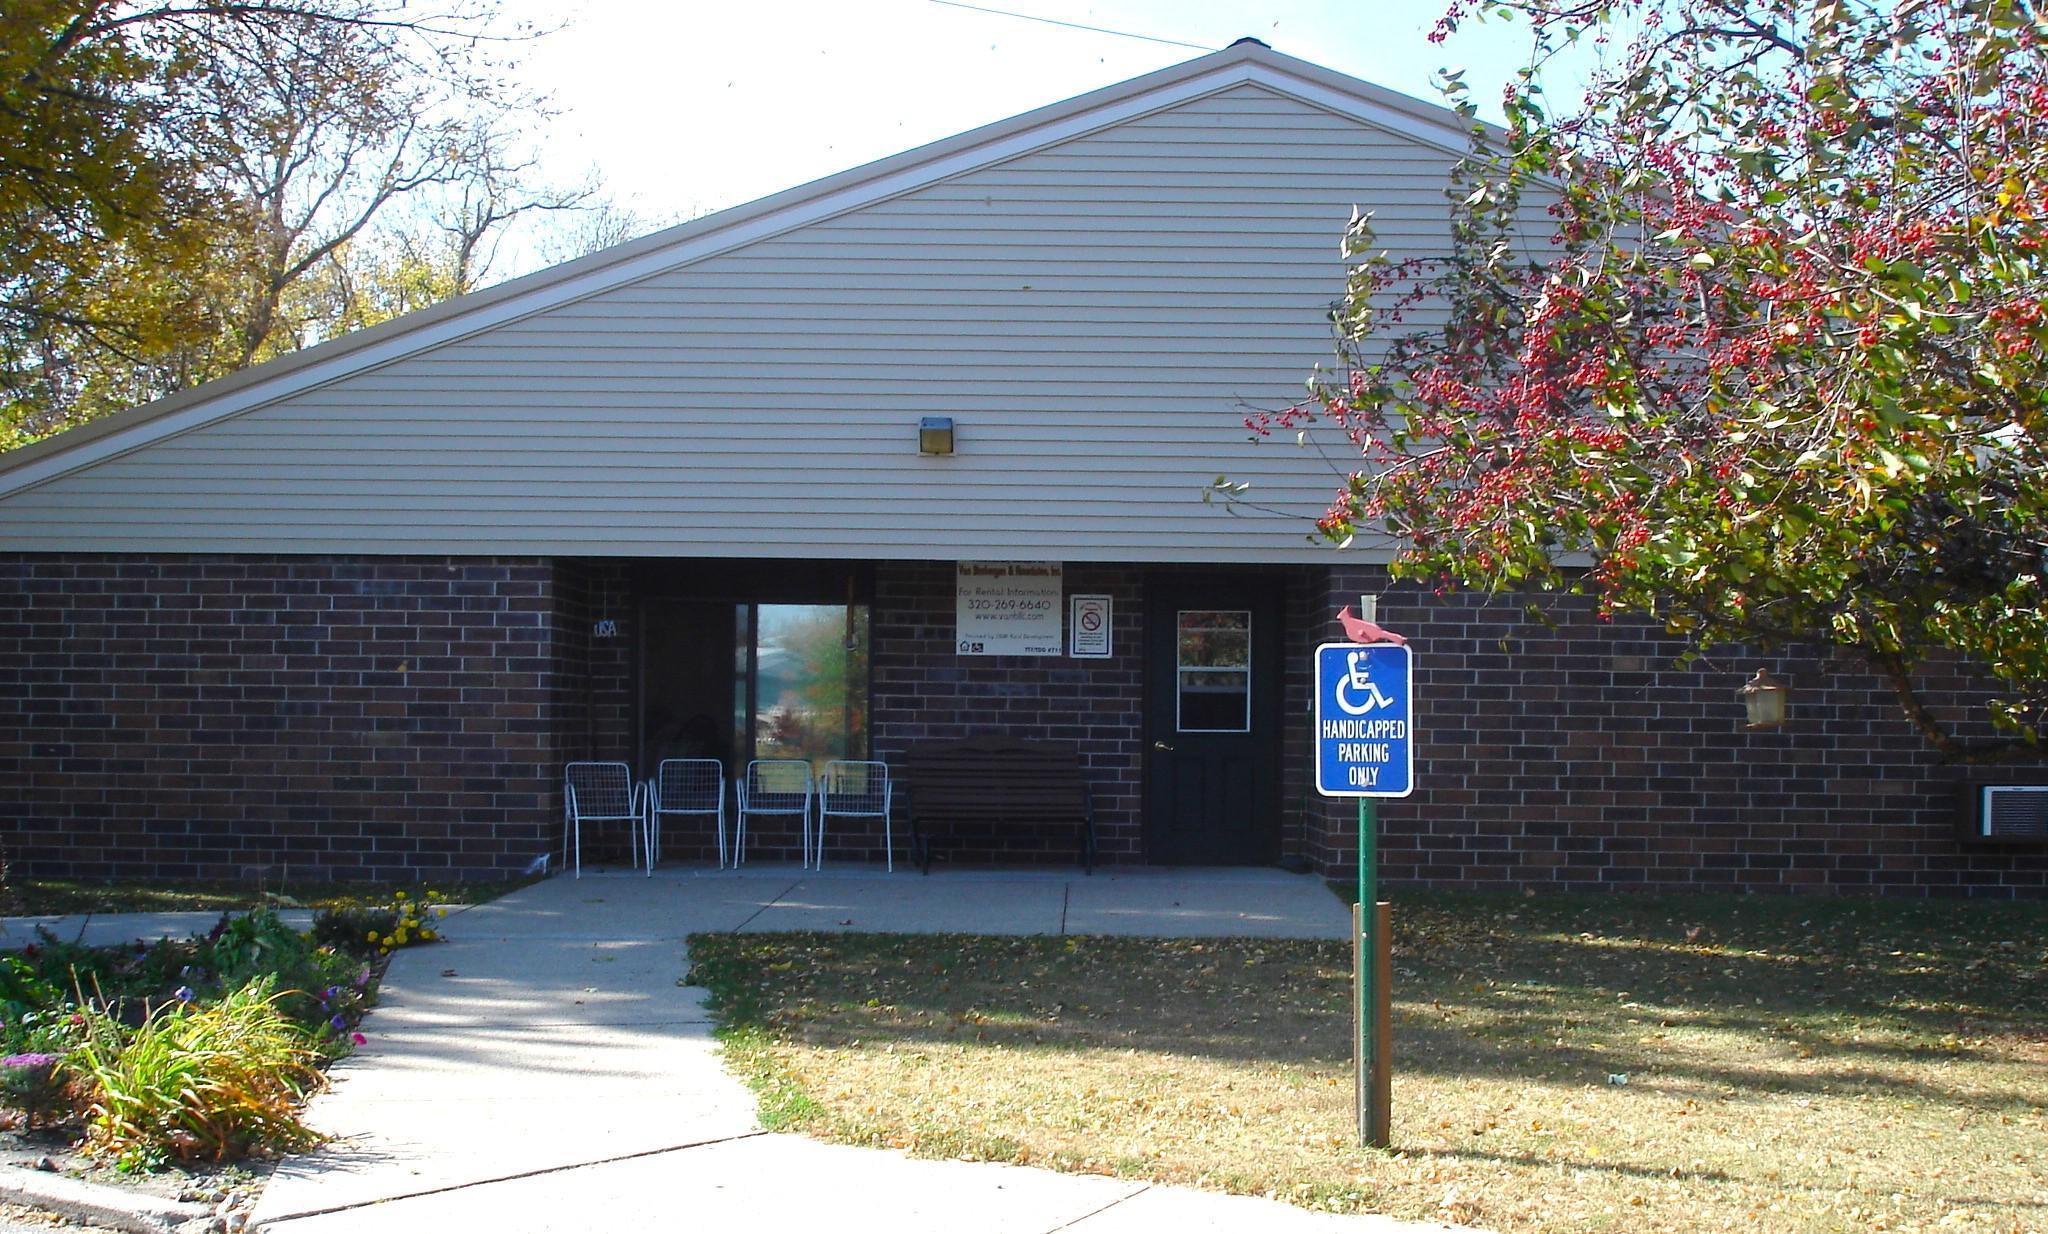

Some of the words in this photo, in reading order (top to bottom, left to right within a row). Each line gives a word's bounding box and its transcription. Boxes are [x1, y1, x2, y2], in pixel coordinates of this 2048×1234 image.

[958, 587, 973, 597] For
[976, 587, 1004, 597] Rental
[967, 599, 1051, 610] 320-269-6640
[593, 620, 617, 638] USA
[1322, 719, 1405, 739] HANDICAPPED
[1338, 743, 1389, 763] PARKING
[1349, 766, 1379, 786] ONLY
